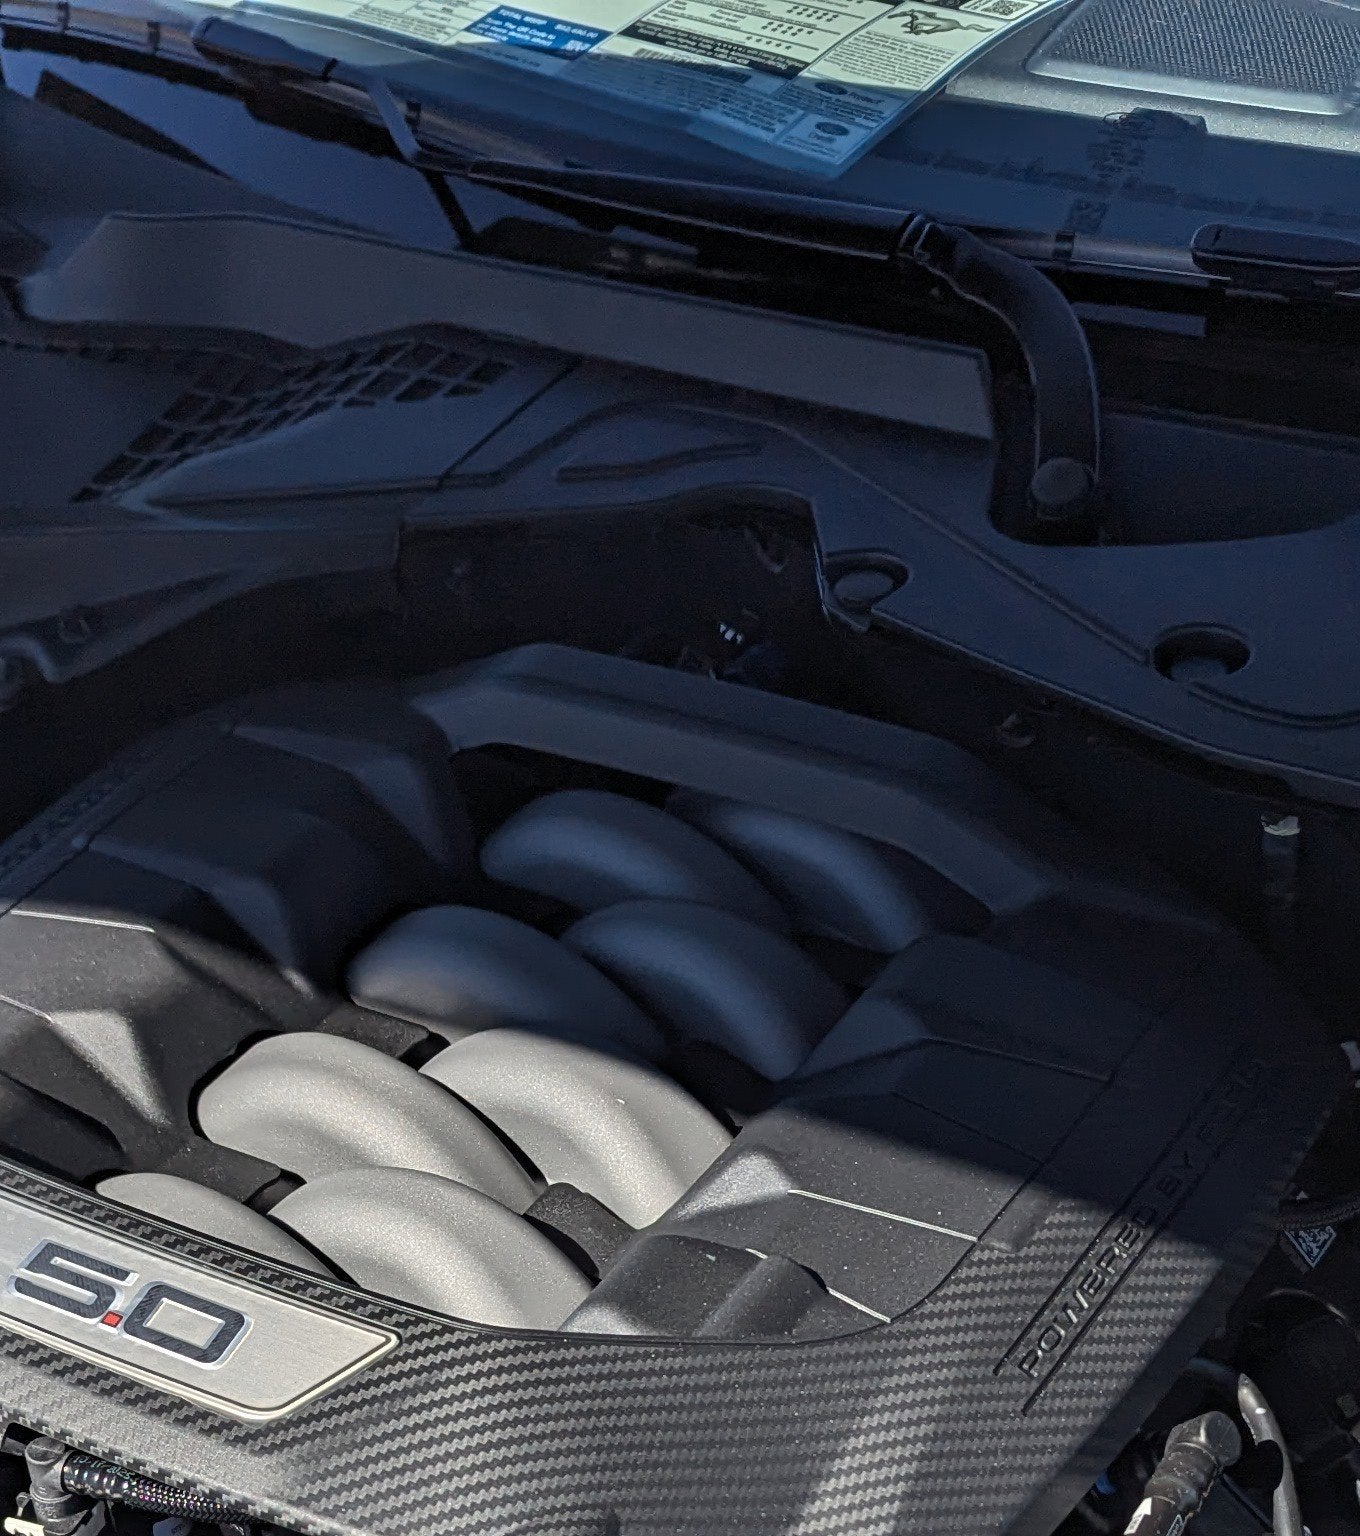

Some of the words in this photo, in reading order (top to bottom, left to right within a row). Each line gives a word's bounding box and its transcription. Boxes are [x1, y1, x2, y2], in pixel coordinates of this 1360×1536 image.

[6, 1238, 255, 1371] 5.0
[1017, 1205, 1158, 1380] POWERED
[1154, 1149, 1195, 1199] BY
